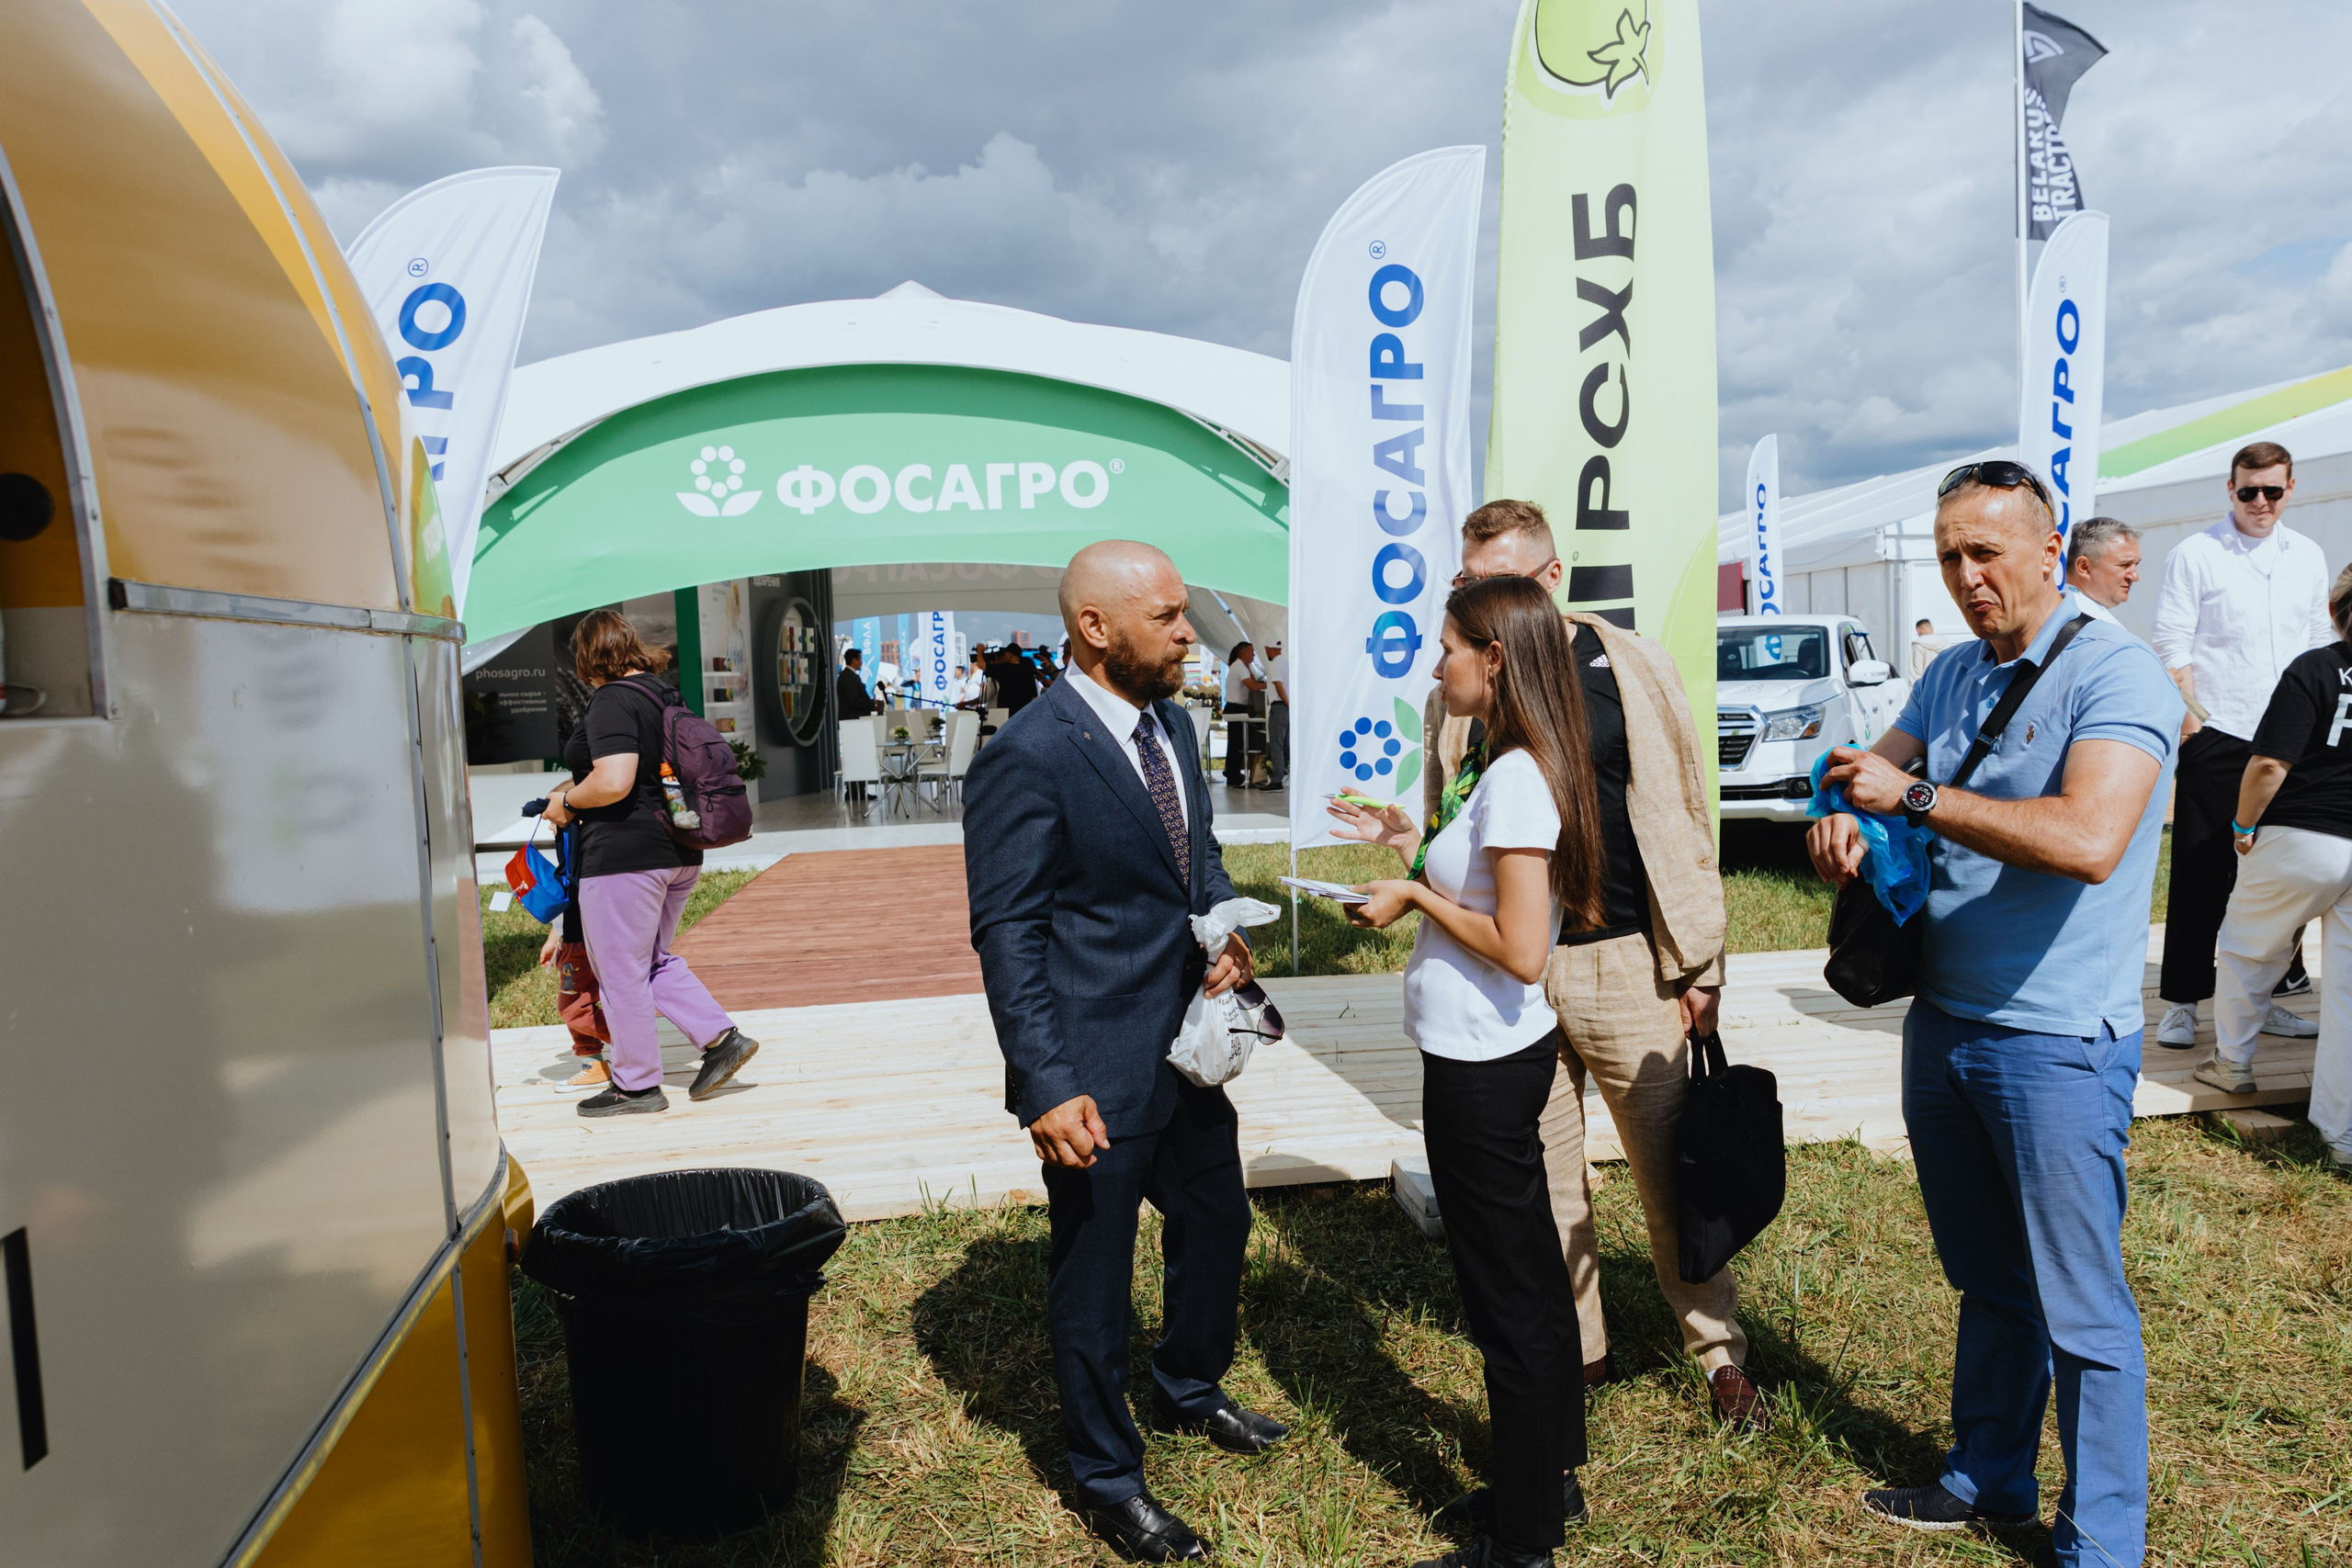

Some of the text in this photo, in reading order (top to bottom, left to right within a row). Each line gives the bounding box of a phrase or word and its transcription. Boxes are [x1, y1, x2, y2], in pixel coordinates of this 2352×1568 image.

[1571, 183, 1637, 530] РСХБ
[476, 668, 546, 681] phosagro.ru
[933, 612, 947, 691] ФОСАГР
